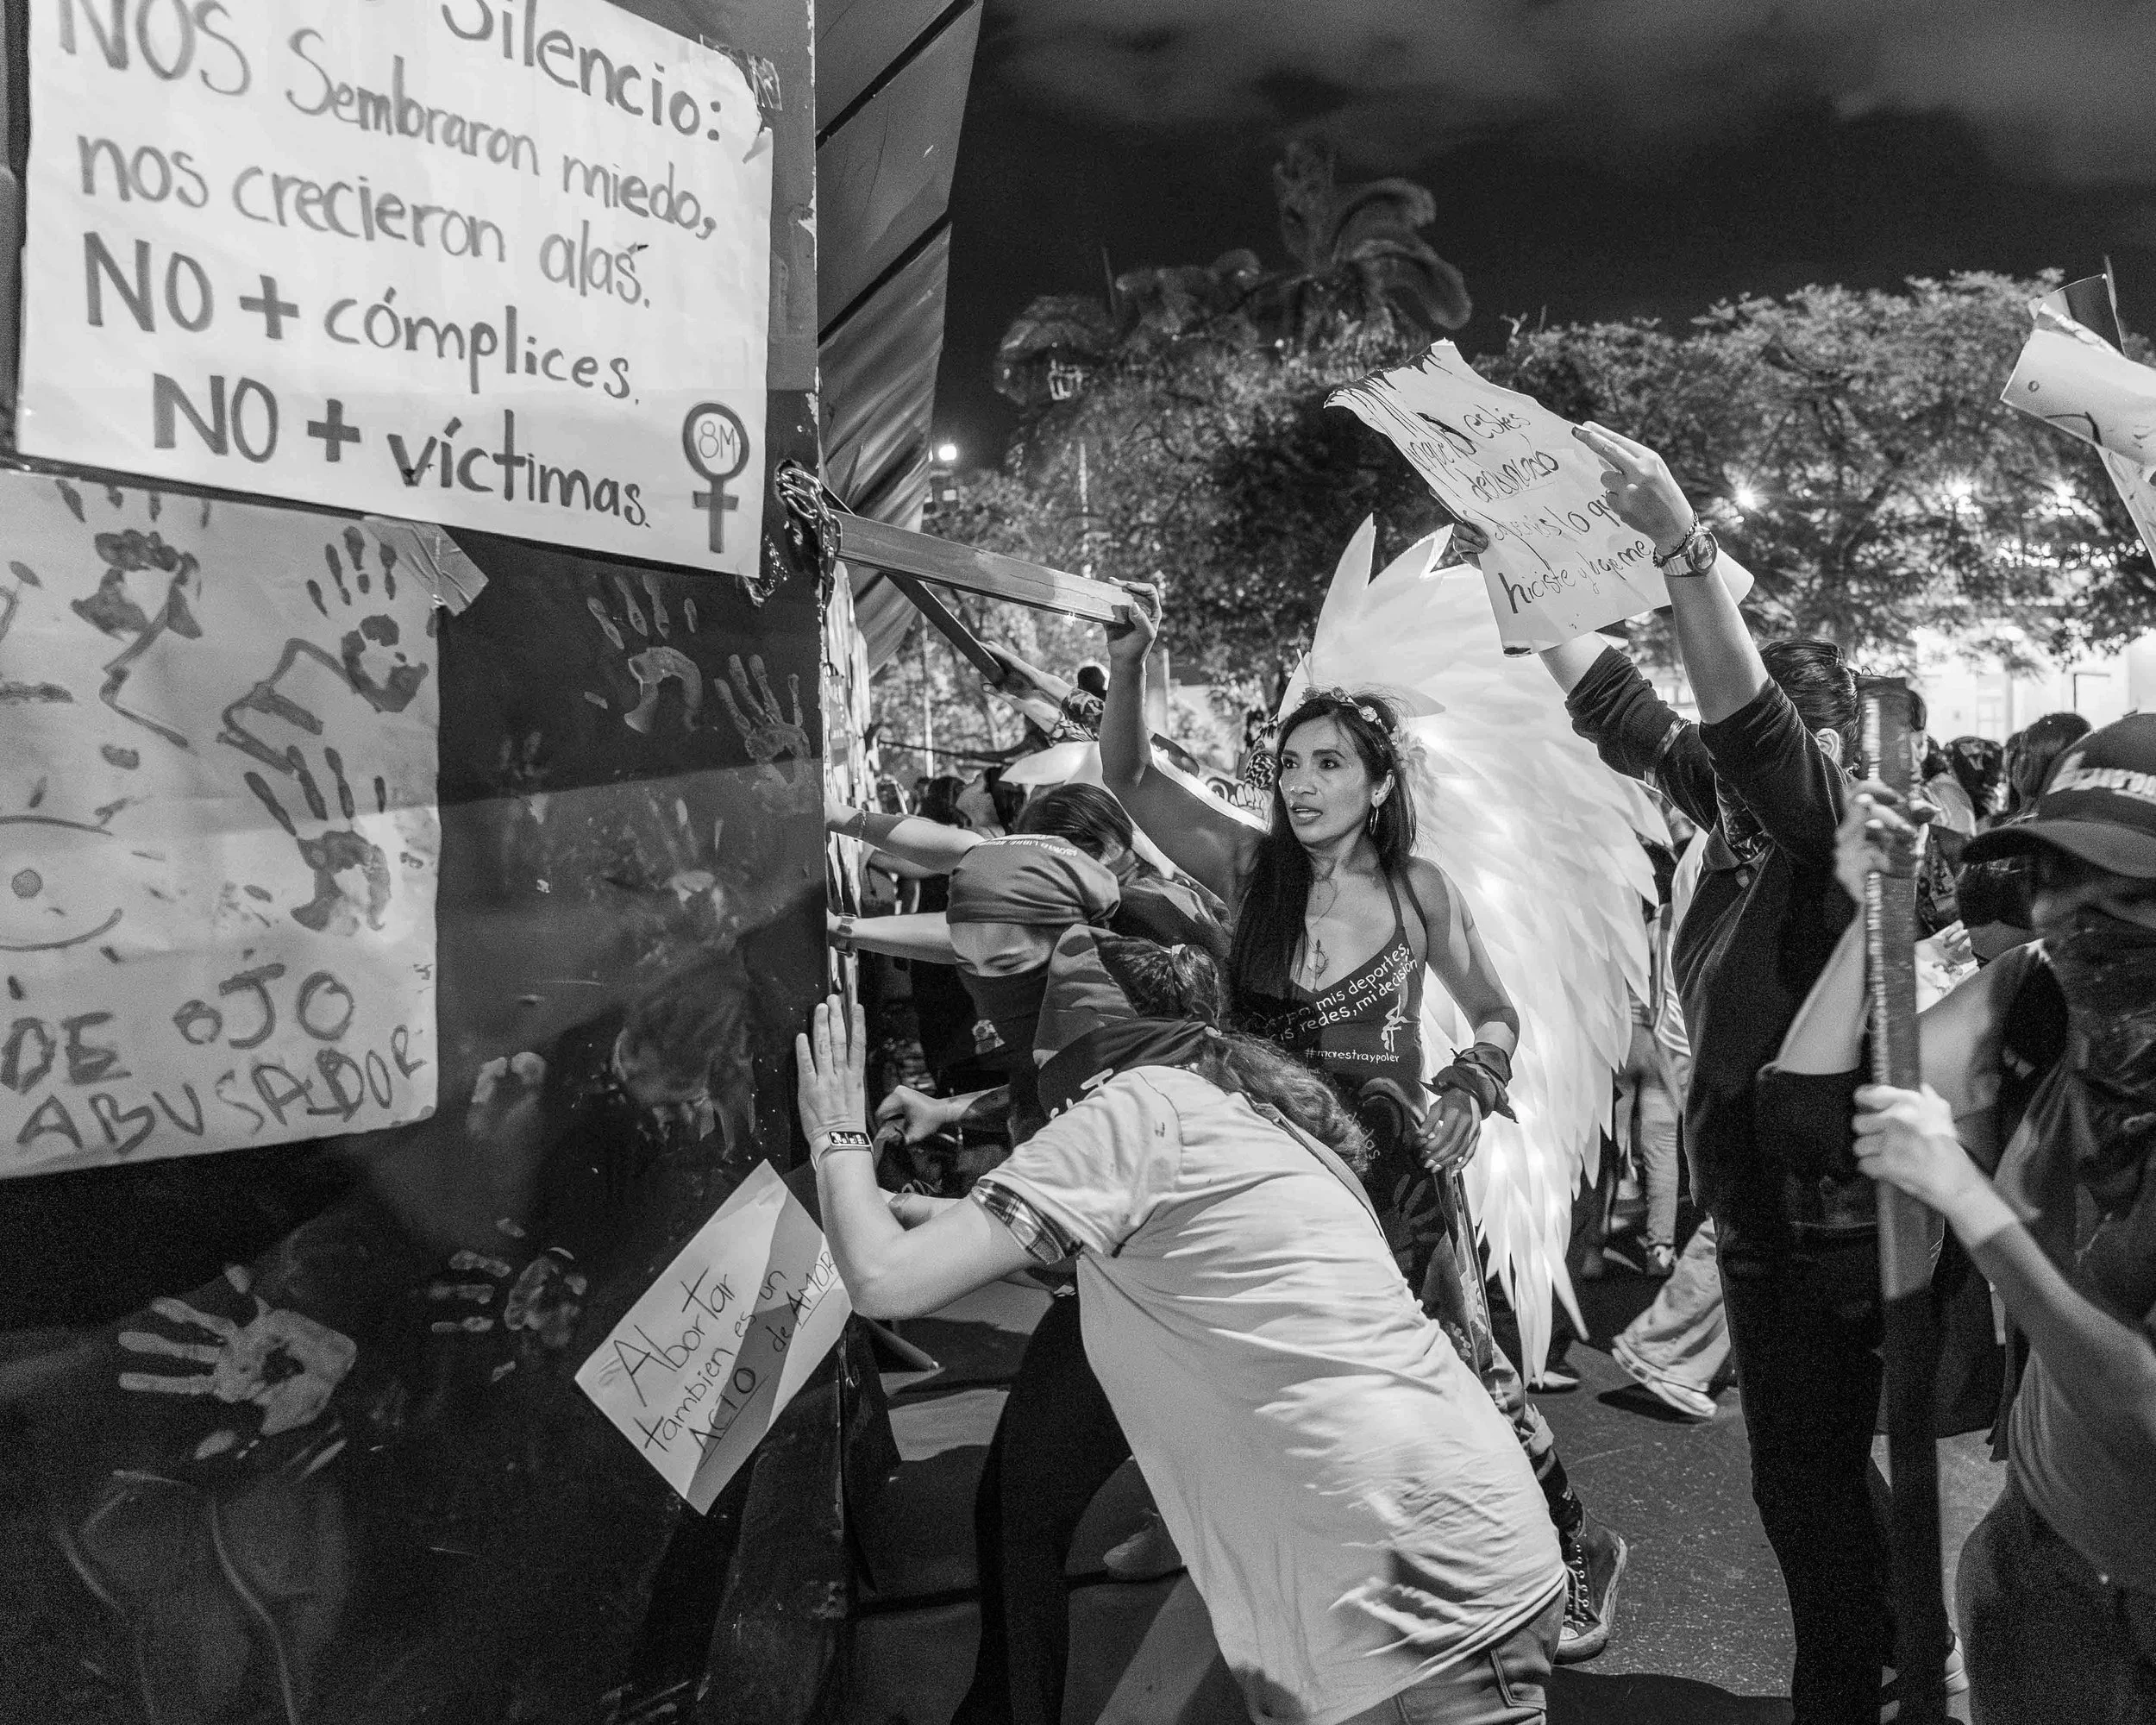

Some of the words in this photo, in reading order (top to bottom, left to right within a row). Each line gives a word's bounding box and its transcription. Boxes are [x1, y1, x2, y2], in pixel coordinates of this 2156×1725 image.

[59, 0, 251, 96] NOS
[285, 28, 541, 177] Sembraron
[563, 154, 718, 241] miedo,
[76, 135, 209, 209] nos
[232, 166, 507, 263] crecieron
[84, 231, 215, 334] NO
[239, 274, 300, 340] +
[325, 288, 640, 406] cómplices.
[153, 373, 279, 464] NO
[307, 398, 360, 463] +
[386, 409, 652, 530] víctimas.
[699, 420, 736, 465] 8M
[1498, 552, 1576, 614] hiciste
[1300, 1004, 1357, 1033] redes,
[1356, 989, 1388, 1012] mi
[1316, 989, 1345, 1011] mis
[1348, 942, 1411, 995] deportes,
[0, 1012, 132, 1095] DE
[734, 1312, 757, 1339] es
[759, 1270, 787, 1301] un
[688, 1365, 757, 1453] ACTO
[765, 1323, 793, 1353] de
